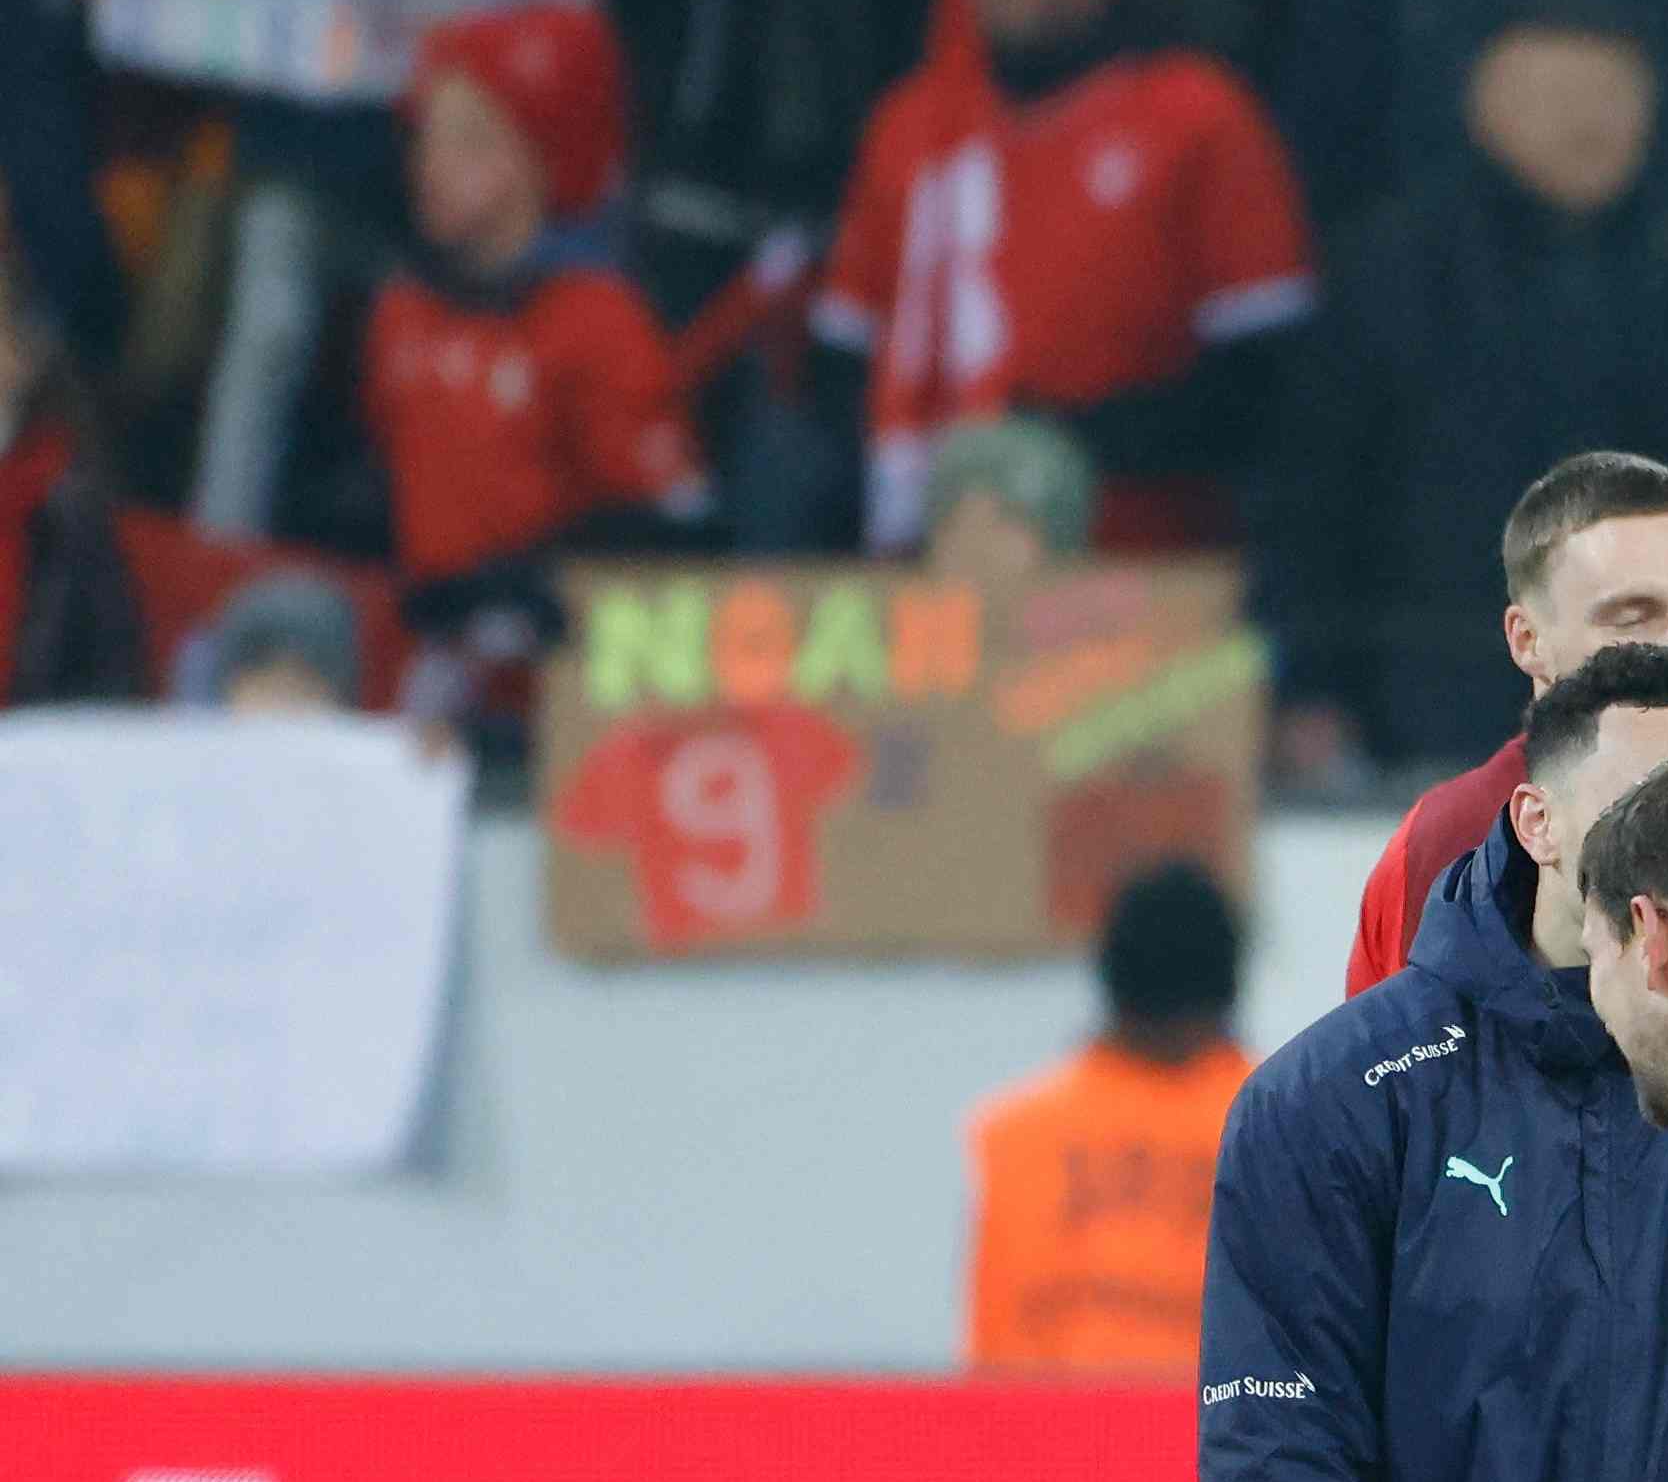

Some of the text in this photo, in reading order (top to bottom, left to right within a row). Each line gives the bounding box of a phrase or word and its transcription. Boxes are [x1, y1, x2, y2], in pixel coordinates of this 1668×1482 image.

[583, 577, 984, 709] NOAH
[658, 732, 781, 916] 9
[1364, 1038, 1459, 1087] CREDIT SUISSE
[1203, 1376, 1306, 1406] CREDIT SUISSE
